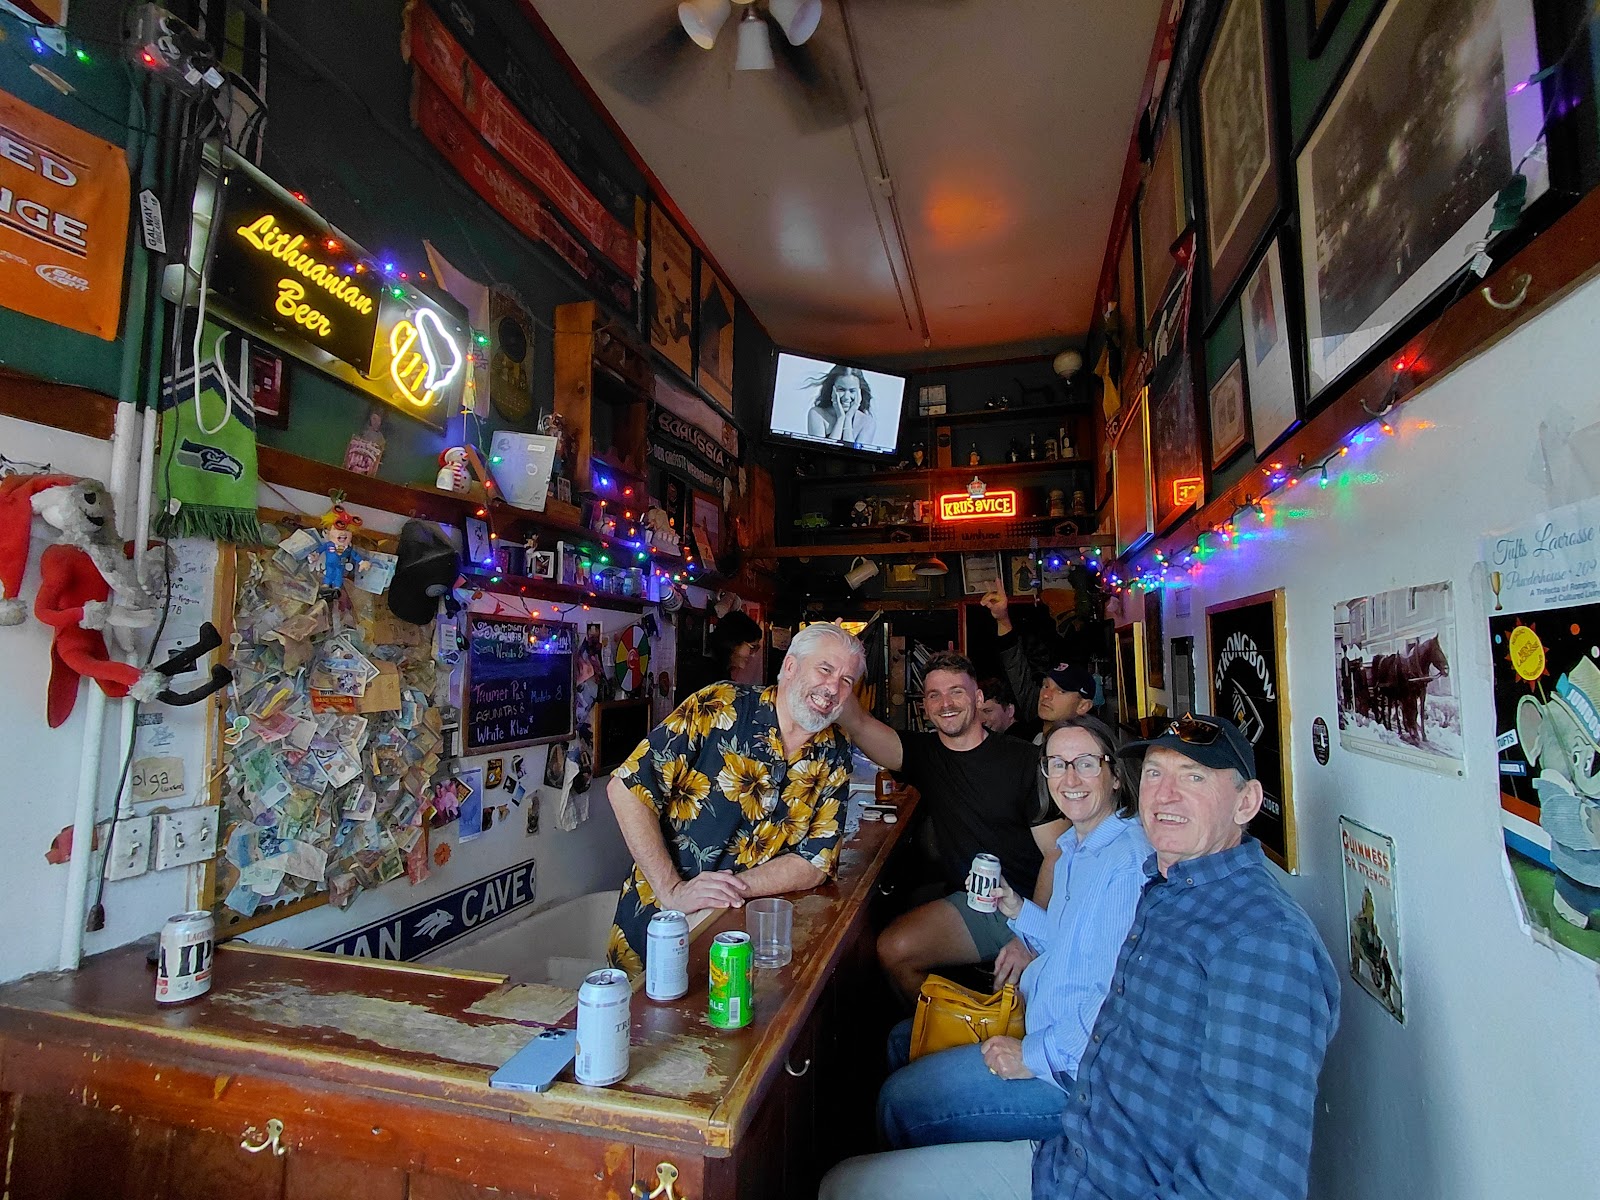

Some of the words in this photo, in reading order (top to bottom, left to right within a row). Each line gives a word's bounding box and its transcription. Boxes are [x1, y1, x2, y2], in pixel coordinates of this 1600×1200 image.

[144, 205, 156, 246] GALWAY
[46, 272, 90, 292] LIGHT
[52, 267, 90, 285] BUD
[237, 215, 372, 314] Lithuanian
[275, 278, 332, 336] Beer
[658, 412, 724, 468] BORUSSIA
[1492, 538, 1528, 568] Tufts
[1533, 523, 1594, 559] Lacrosse
[1215, 632, 1275, 702] STRONGBOW
[1566, 688, 1600, 738] JUMBOS
[1497, 734, 1514, 748] TUFTS
[1262, 796, 1280, 816] CIDER
[1342, 829, 1390, 872] GUINNESS
[460, 868, 527, 928] CAVE
